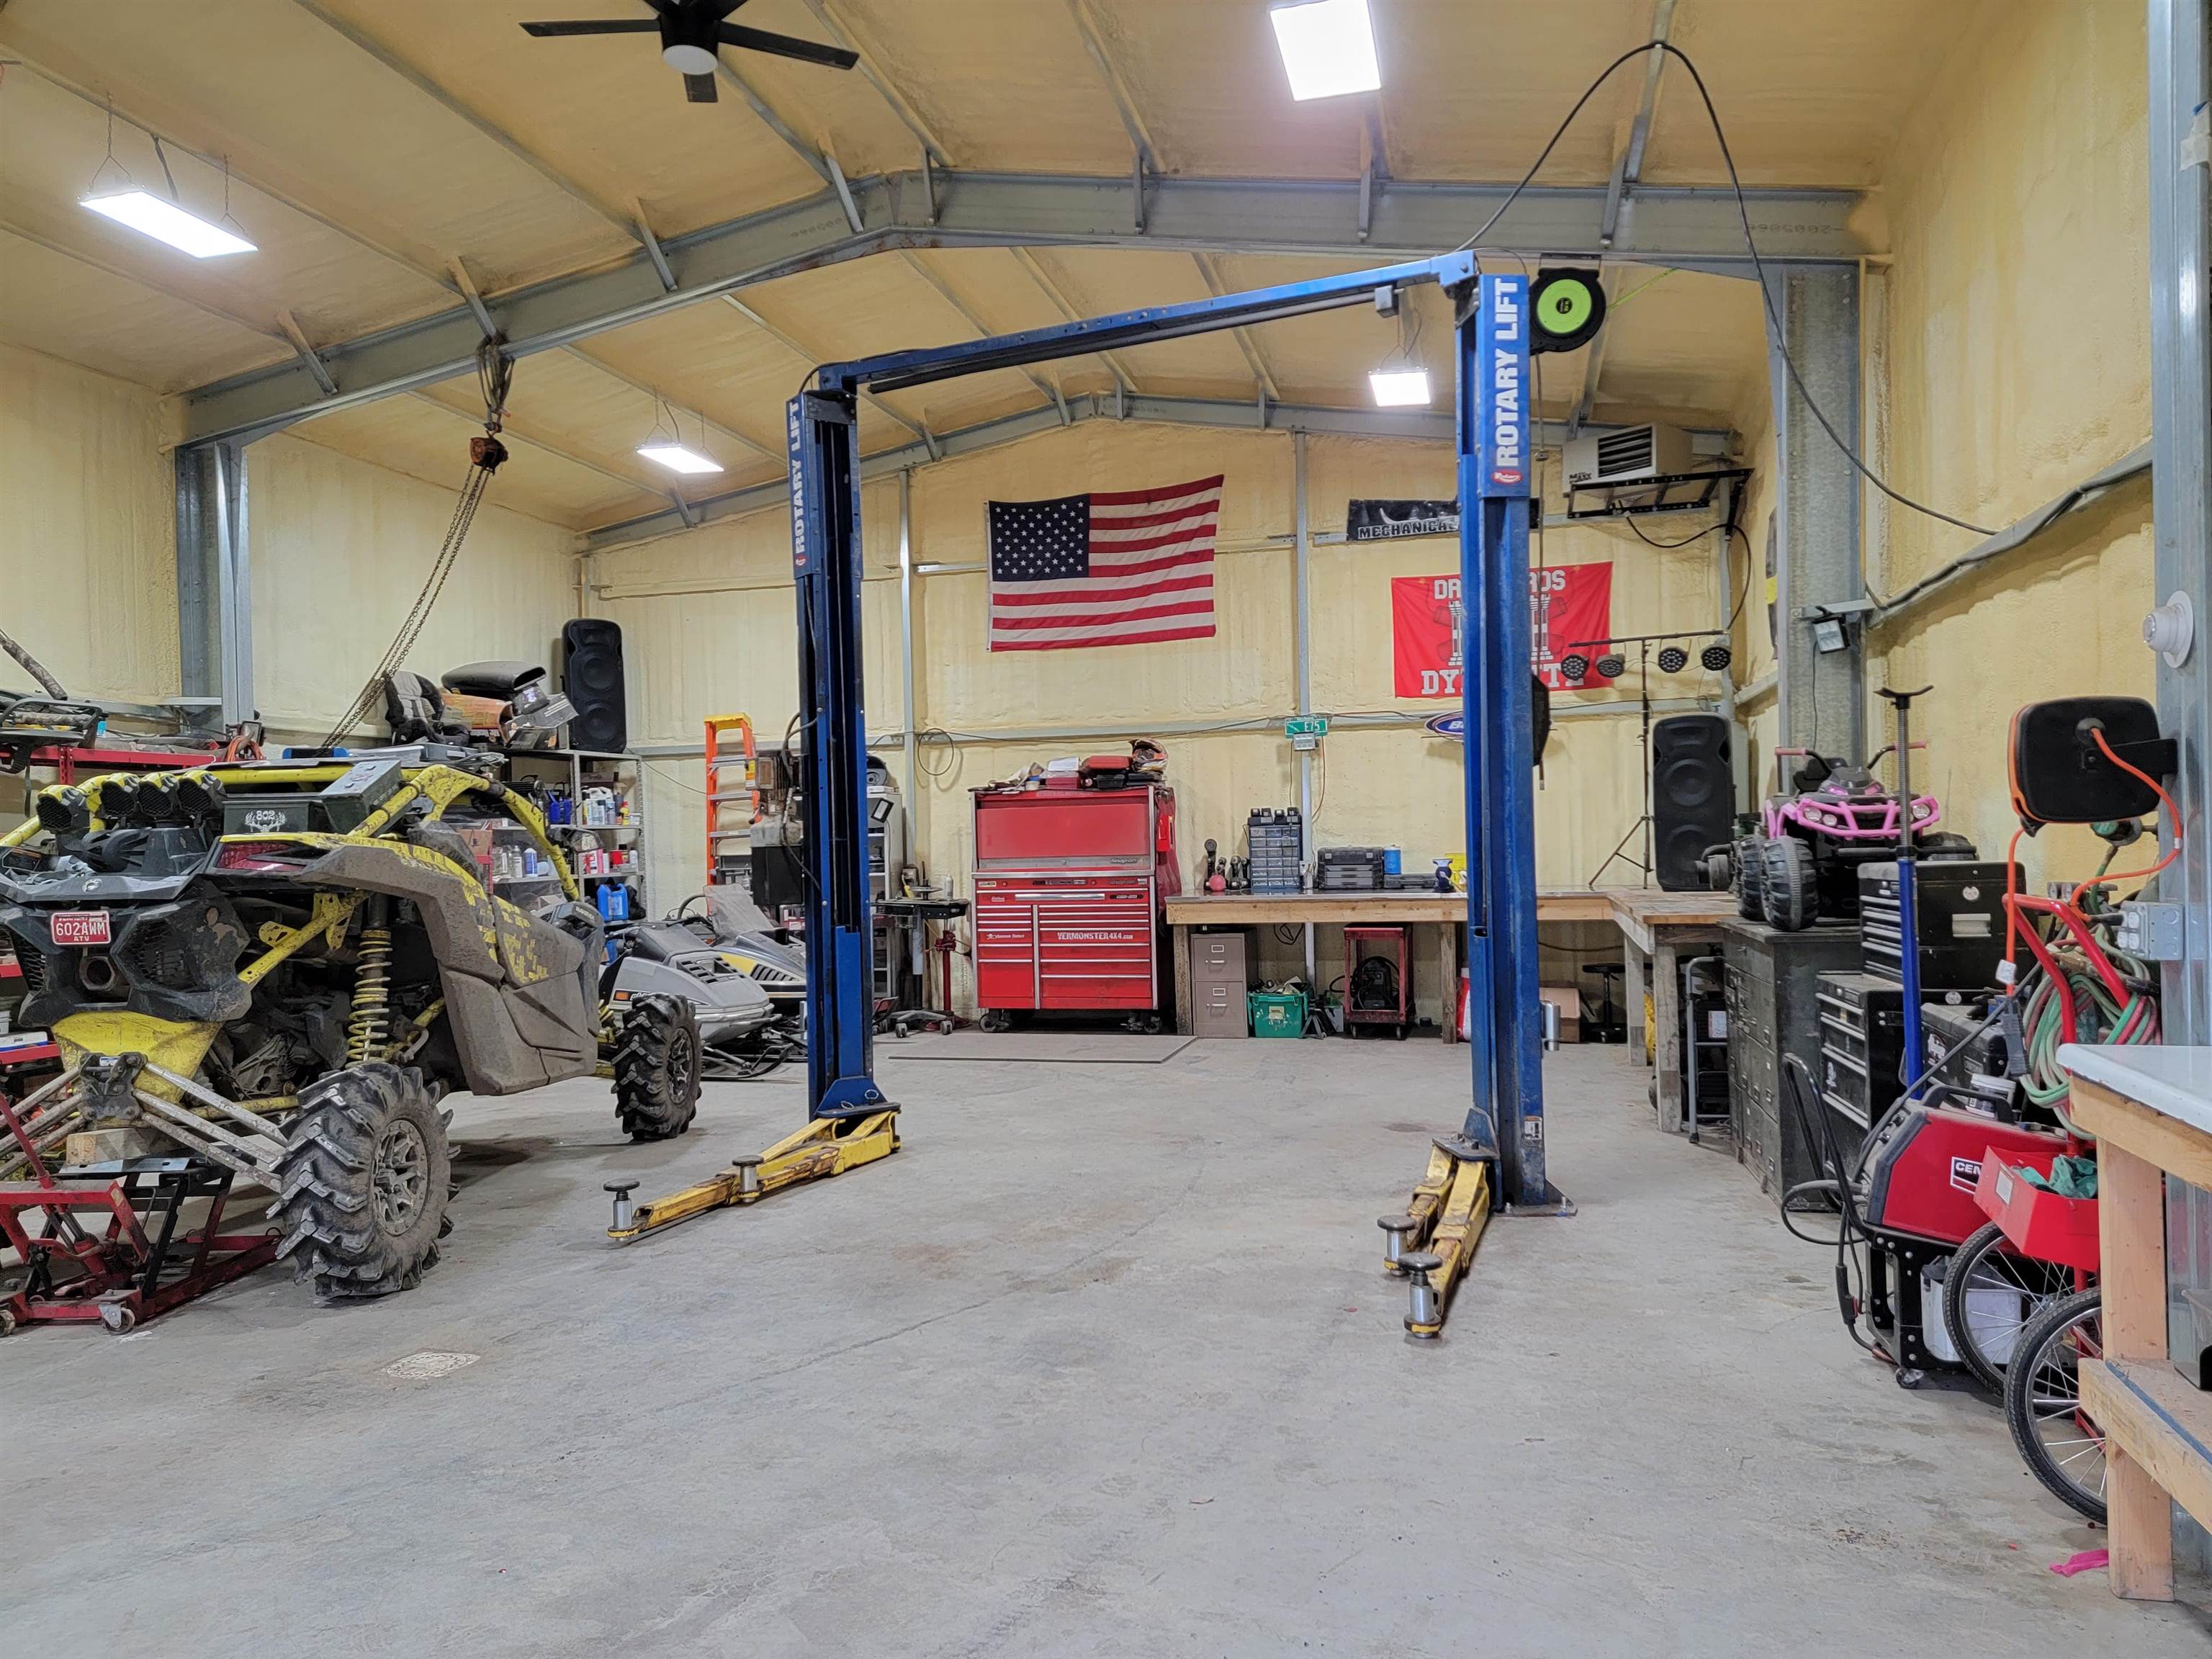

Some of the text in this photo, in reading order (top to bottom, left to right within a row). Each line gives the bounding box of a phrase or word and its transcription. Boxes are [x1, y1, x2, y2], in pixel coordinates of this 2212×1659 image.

[1495, 278, 1519, 467] ROTARY LIFT
[789, 401, 805, 554] ROTARY LIFT
[256, 810, 275, 820] 802
[56, 922, 106, 935] 602AWM
